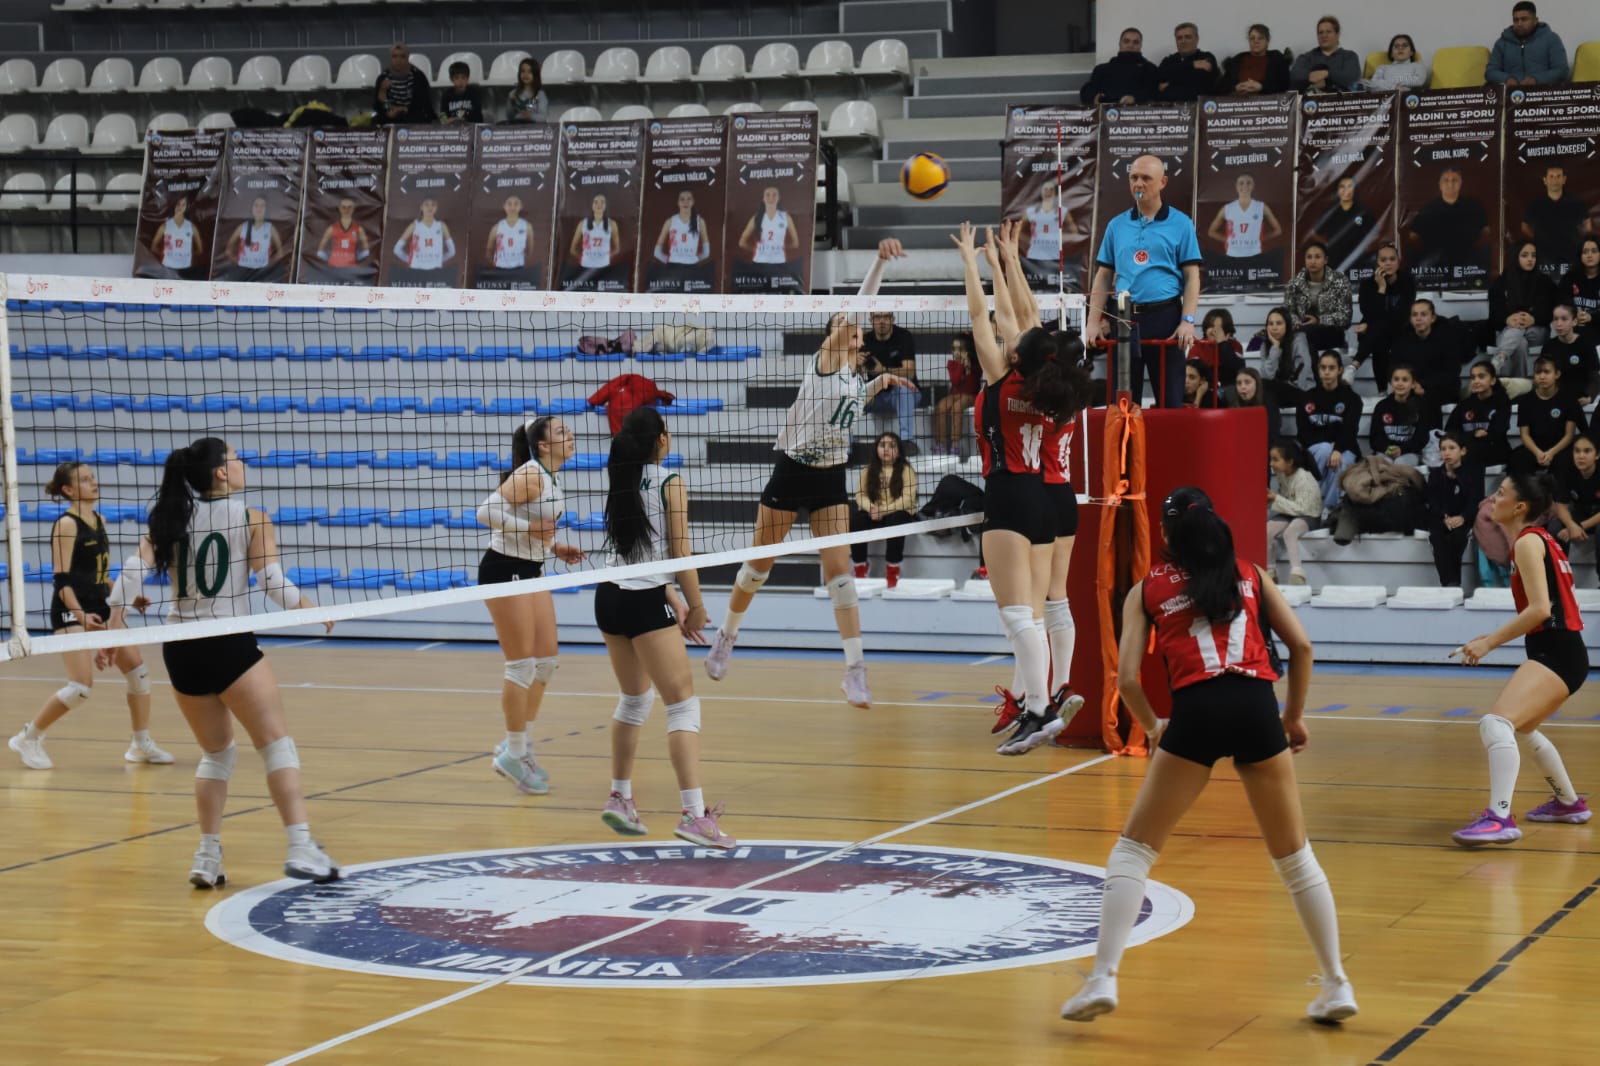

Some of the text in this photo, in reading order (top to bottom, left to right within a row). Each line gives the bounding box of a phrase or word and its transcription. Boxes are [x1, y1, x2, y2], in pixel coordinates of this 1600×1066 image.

[1409, 112, 1444, 121] KADINI
[1460, 109, 1495, 119] SPORU
[1514, 108, 1550, 117] KADINI
[1567, 105, 1600, 114] SPORU
[1207, 118, 1240, 127] KADINI
[1255, 116, 1288, 125] SPORU
[1308, 118, 1342, 127] KADINI
[1357, 114, 1390, 123] SPORU
[1014, 126, 1046, 134] KADINI
[1109, 126, 1141, 134] KADINI
[1156, 125, 1189, 134] SPORU
[652, 139, 680, 147] KADINI
[693, 137, 721, 145] SPORU
[737, 134, 766, 142] KADINI
[780, 133, 810, 141] SPORU
[399, 145, 427, 153] KADINI
[482, 145, 510, 153] KADINI
[568, 141, 597, 149] KADINI
[609, 140, 638, 148] SPORU
[316, 146, 343, 154] KADINI
[356, 146, 384, 154] SPORU
[1527, 146, 1555, 157] MUSTAFA
[1432, 150, 1452, 160] ERDAL
[768, 231, 774, 241] 2
[36, 282, 49, 292] TVF
[100, 285, 113, 294] TVF
[161, 287, 174, 296] TVF
[219, 288, 231, 297] TVF
[274, 290, 286, 298] TVF
[829, 395, 859, 429] 16
[176, 532, 230, 599] 10
